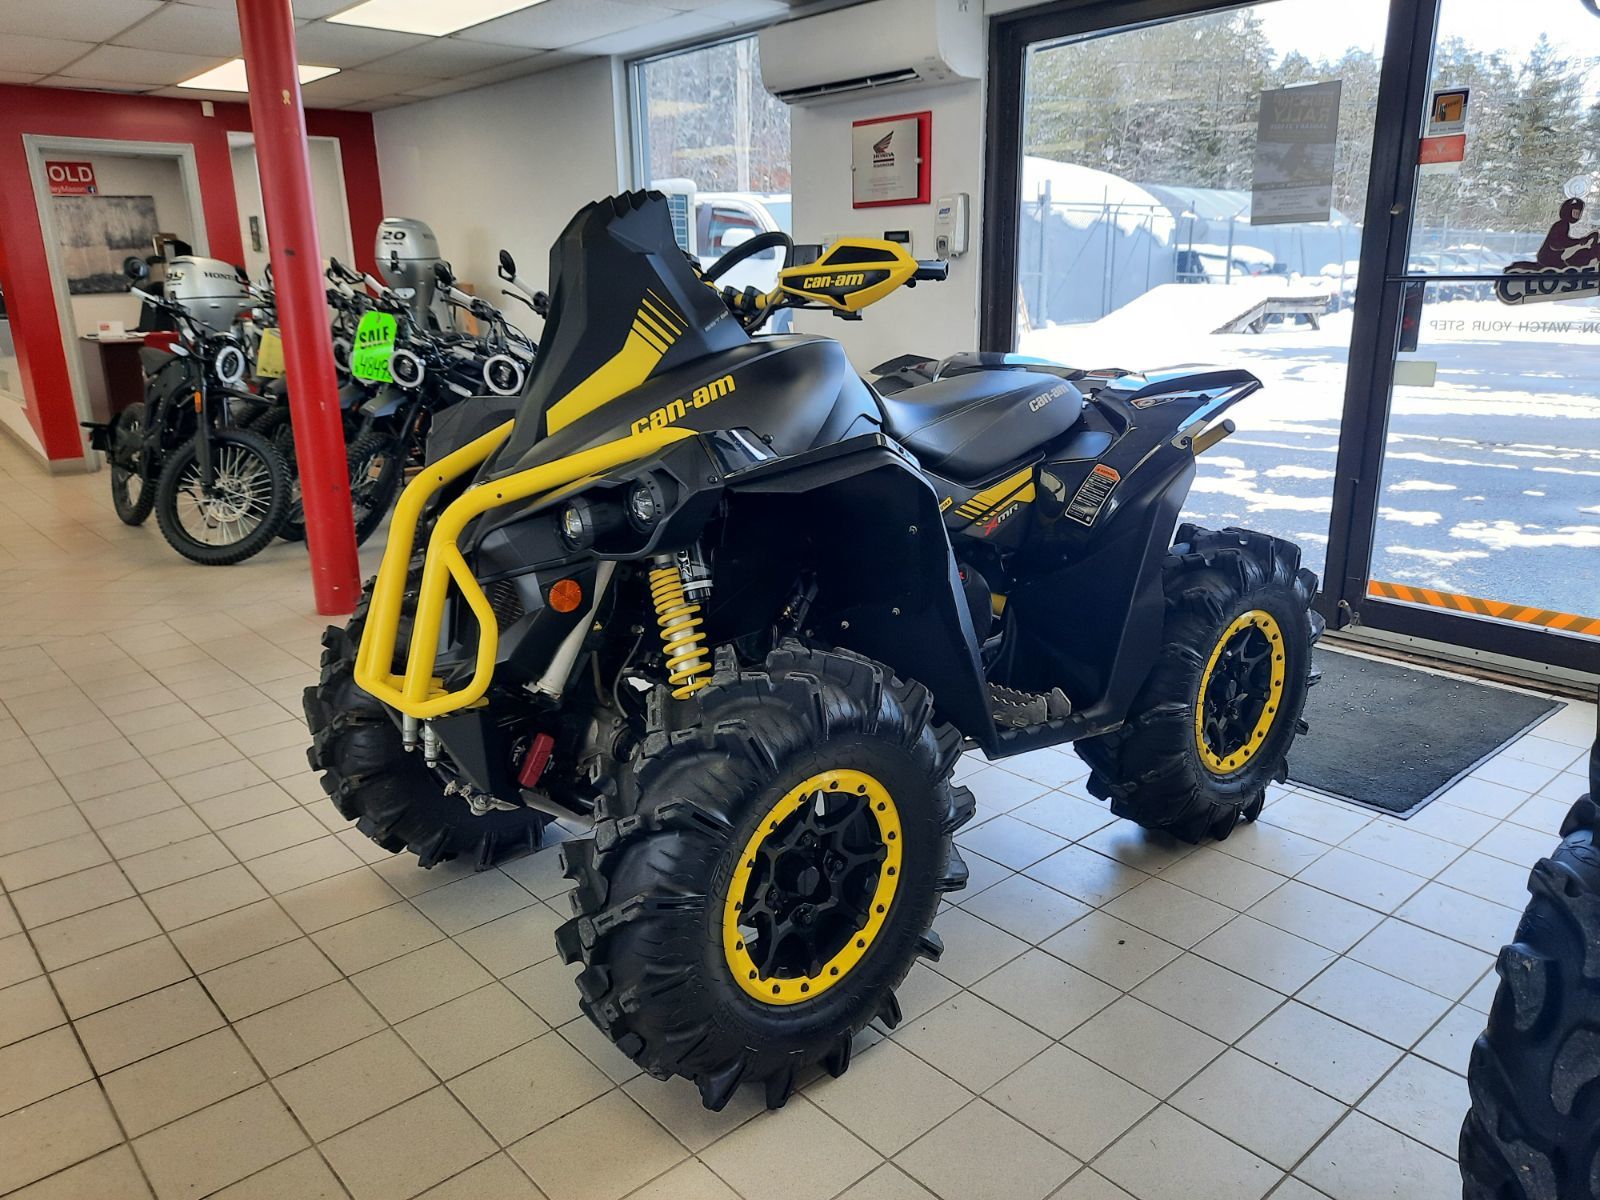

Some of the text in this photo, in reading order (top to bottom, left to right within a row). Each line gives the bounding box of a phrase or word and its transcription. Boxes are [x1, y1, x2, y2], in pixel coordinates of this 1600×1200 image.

[49, 166, 93, 182] OLD
[382, 231, 406, 240] 20
[802, 273, 865, 289] can-am
[1500, 267, 1600, 301] CLOSE
[631, 375, 736, 436] can-am
[1029, 384, 1070, 412] can-am
